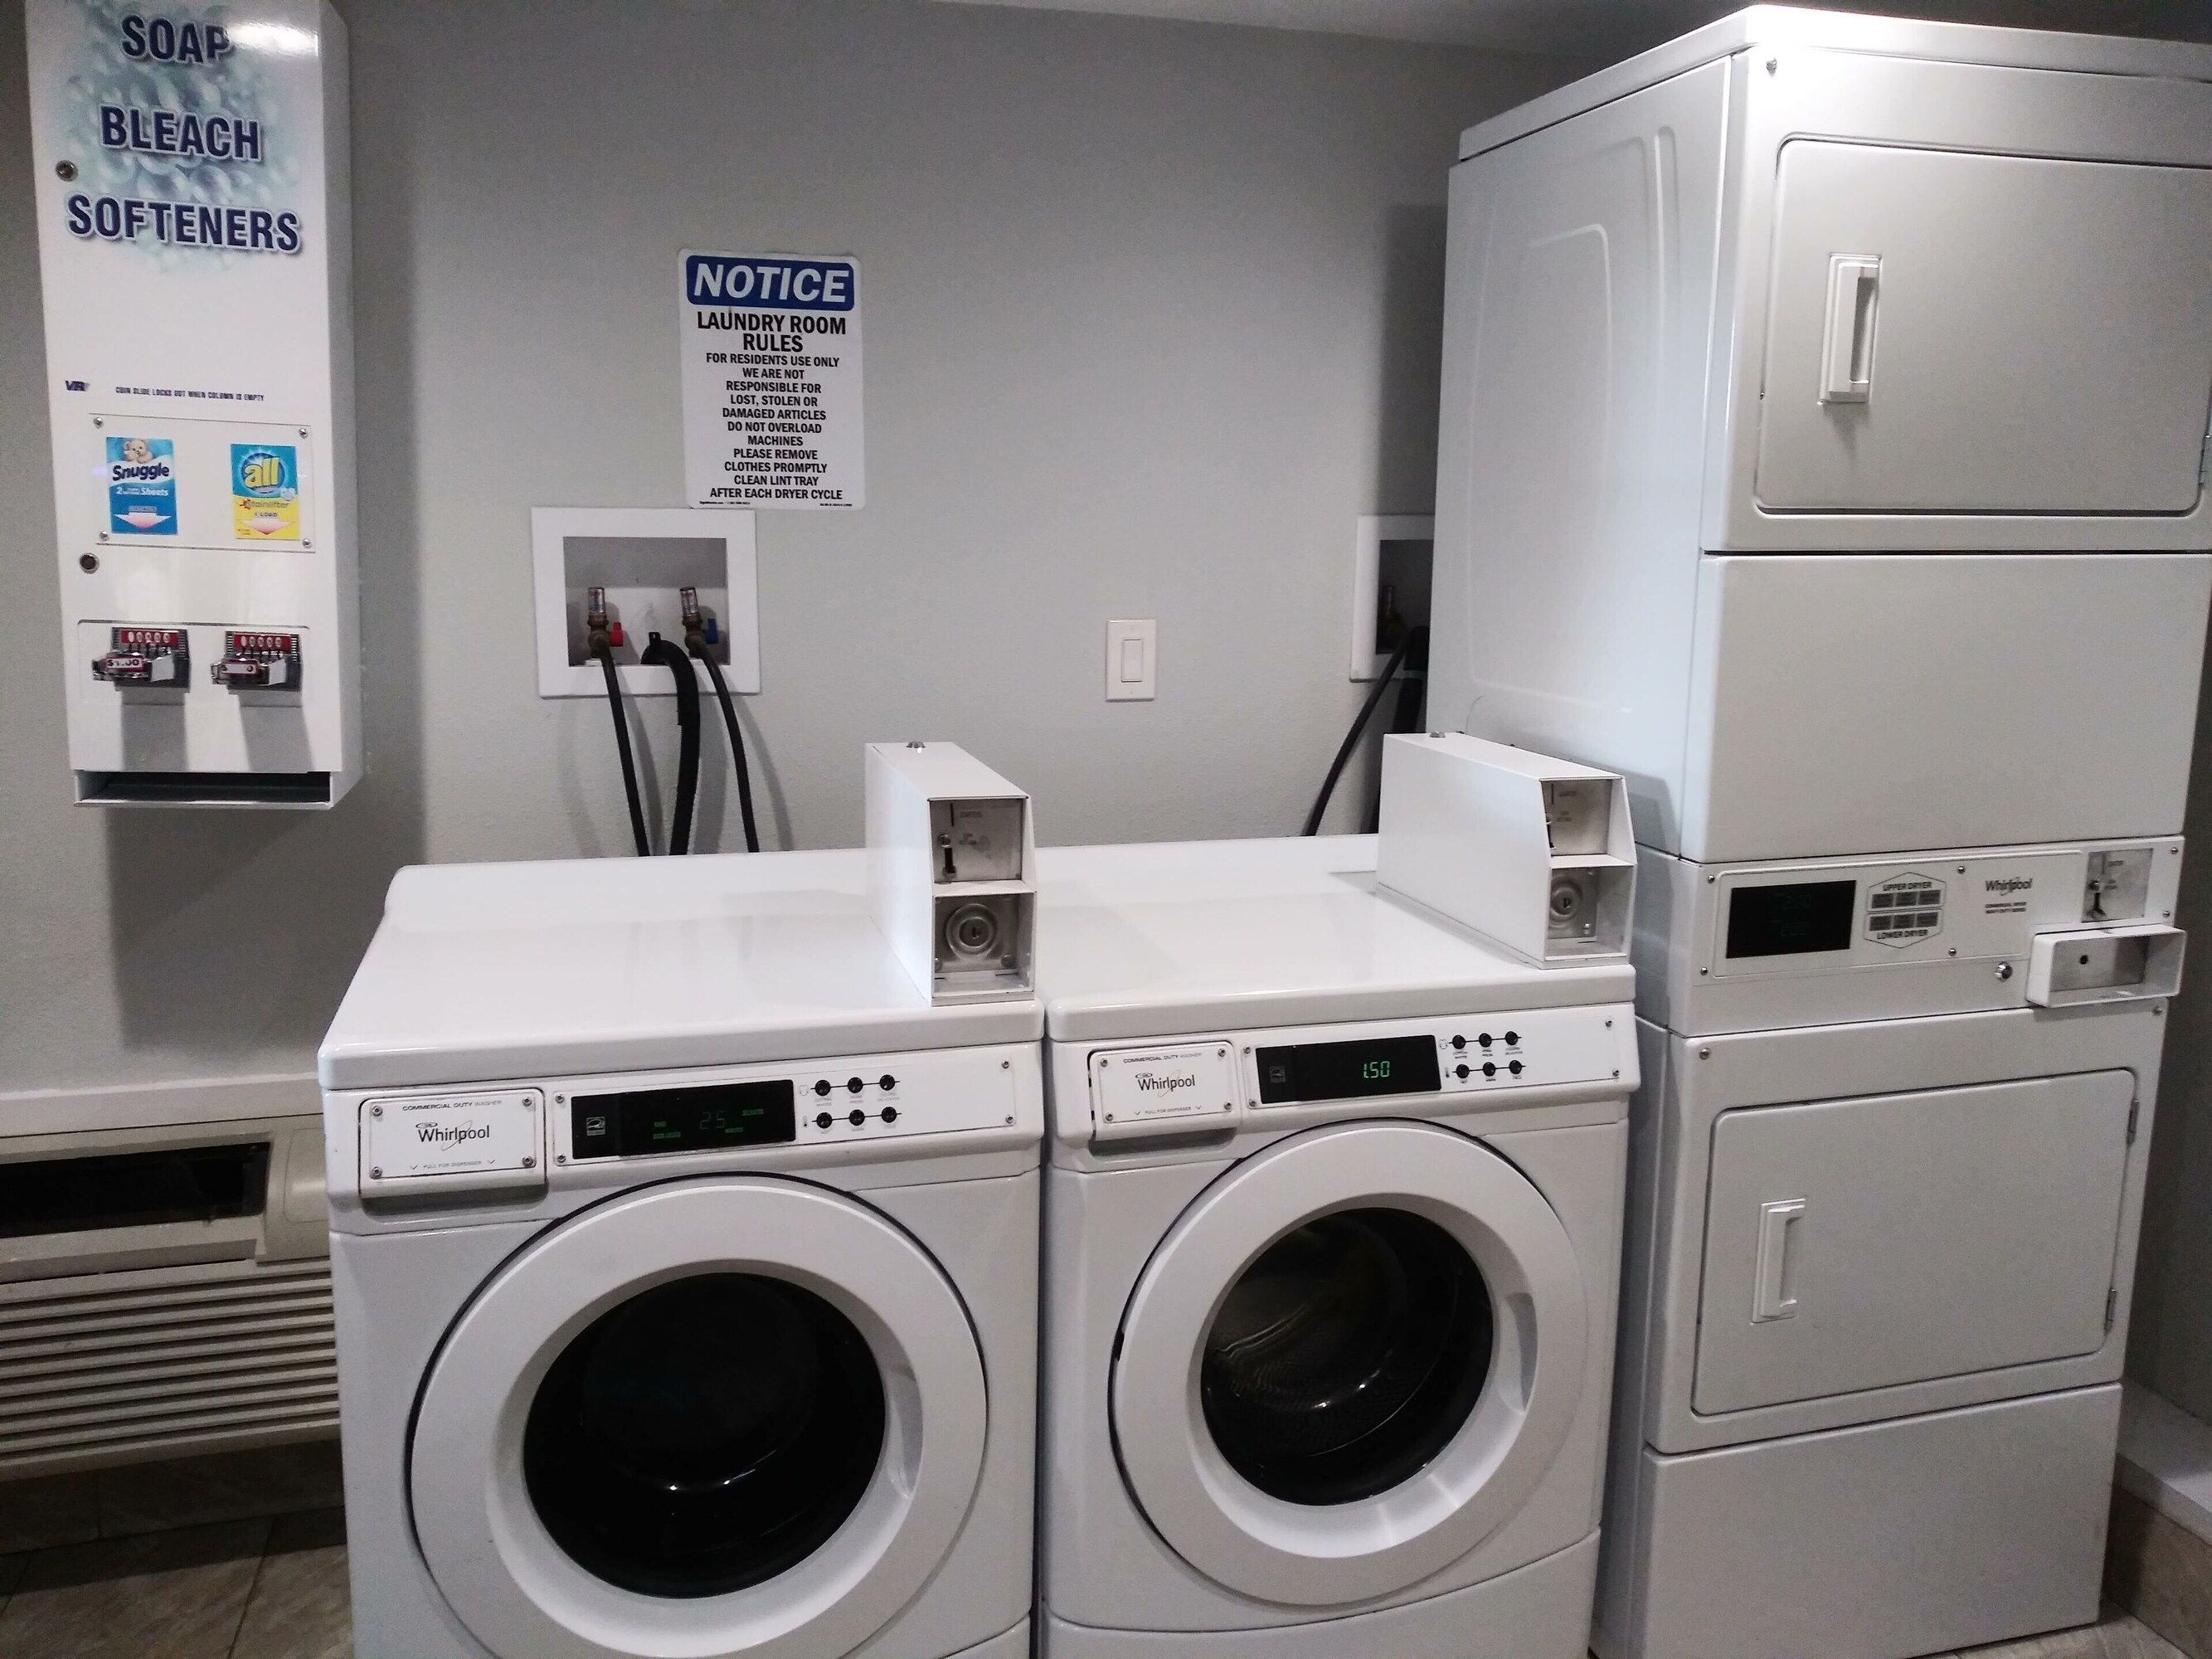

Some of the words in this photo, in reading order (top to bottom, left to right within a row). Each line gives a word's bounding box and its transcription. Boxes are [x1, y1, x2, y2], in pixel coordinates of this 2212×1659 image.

[122, 14, 229, 63] SOAP
[100, 105, 260, 159] BLEACH
[67, 194, 299, 251] SOFTENERS
[693, 263, 849, 303] NOTICE
[698, 311, 785, 332] LAUNDRY
[790, 315, 846, 334] ROOM
[743, 333, 803, 353] RULES
[706, 353, 727, 363] FOR
[730, 353, 788, 366] RESIDENTS
[790, 356, 811, 367] USE
[814, 358, 839, 367] ONLY
[742, 367, 760, 378] WE
[761, 368, 781, 379] ARE
[784, 369, 805, 379] NOT
[726, 381, 799, 393] RESPONSIBLE
[801, 383, 822, 394] FOR
[731, 394, 759, 406] LOST,
[761, 395, 801, 406] STOLEN
[803, 397, 818, 406] OR
[722, 407, 775, 420] DAMAGED
[777, 409, 826, 421] ARTICLES
[727, 421, 742, 431] DO
[745, 421, 766, 432] NOT
[768, 422, 822, 434] OVERLOAD
[747, 435, 803, 446] MACHINES
[733, 448, 772, 459] PLEASE
[775, 449, 818, 460] REMOVE
[113, 462, 169, 481] Snuggle
[245, 457, 280, 489] all
[724, 461, 771, 472] CLOTHES
[774, 462, 828, 474] PROMPTLY
[734, 474, 767, 485] CLEAN
[770, 475, 792, 485] LINT
[794, 476, 819, 486] TRAY
[116, 486, 123, 495] 2
[710, 488, 742, 499] AFTER
[745, 488, 772, 499] EACH
[775, 489, 809, 499] DRYER
[810, 489, 843, 499] CYCLE
[1985, 878, 2032, 894] Whirlpool
[1137, 1074, 1196, 1092] Whirlpool
[402, 1103, 450, 1112] COMMERCIAL
[699, 1110, 726, 1131] 25
[417, 1124, 490, 1144] Whirlpool
